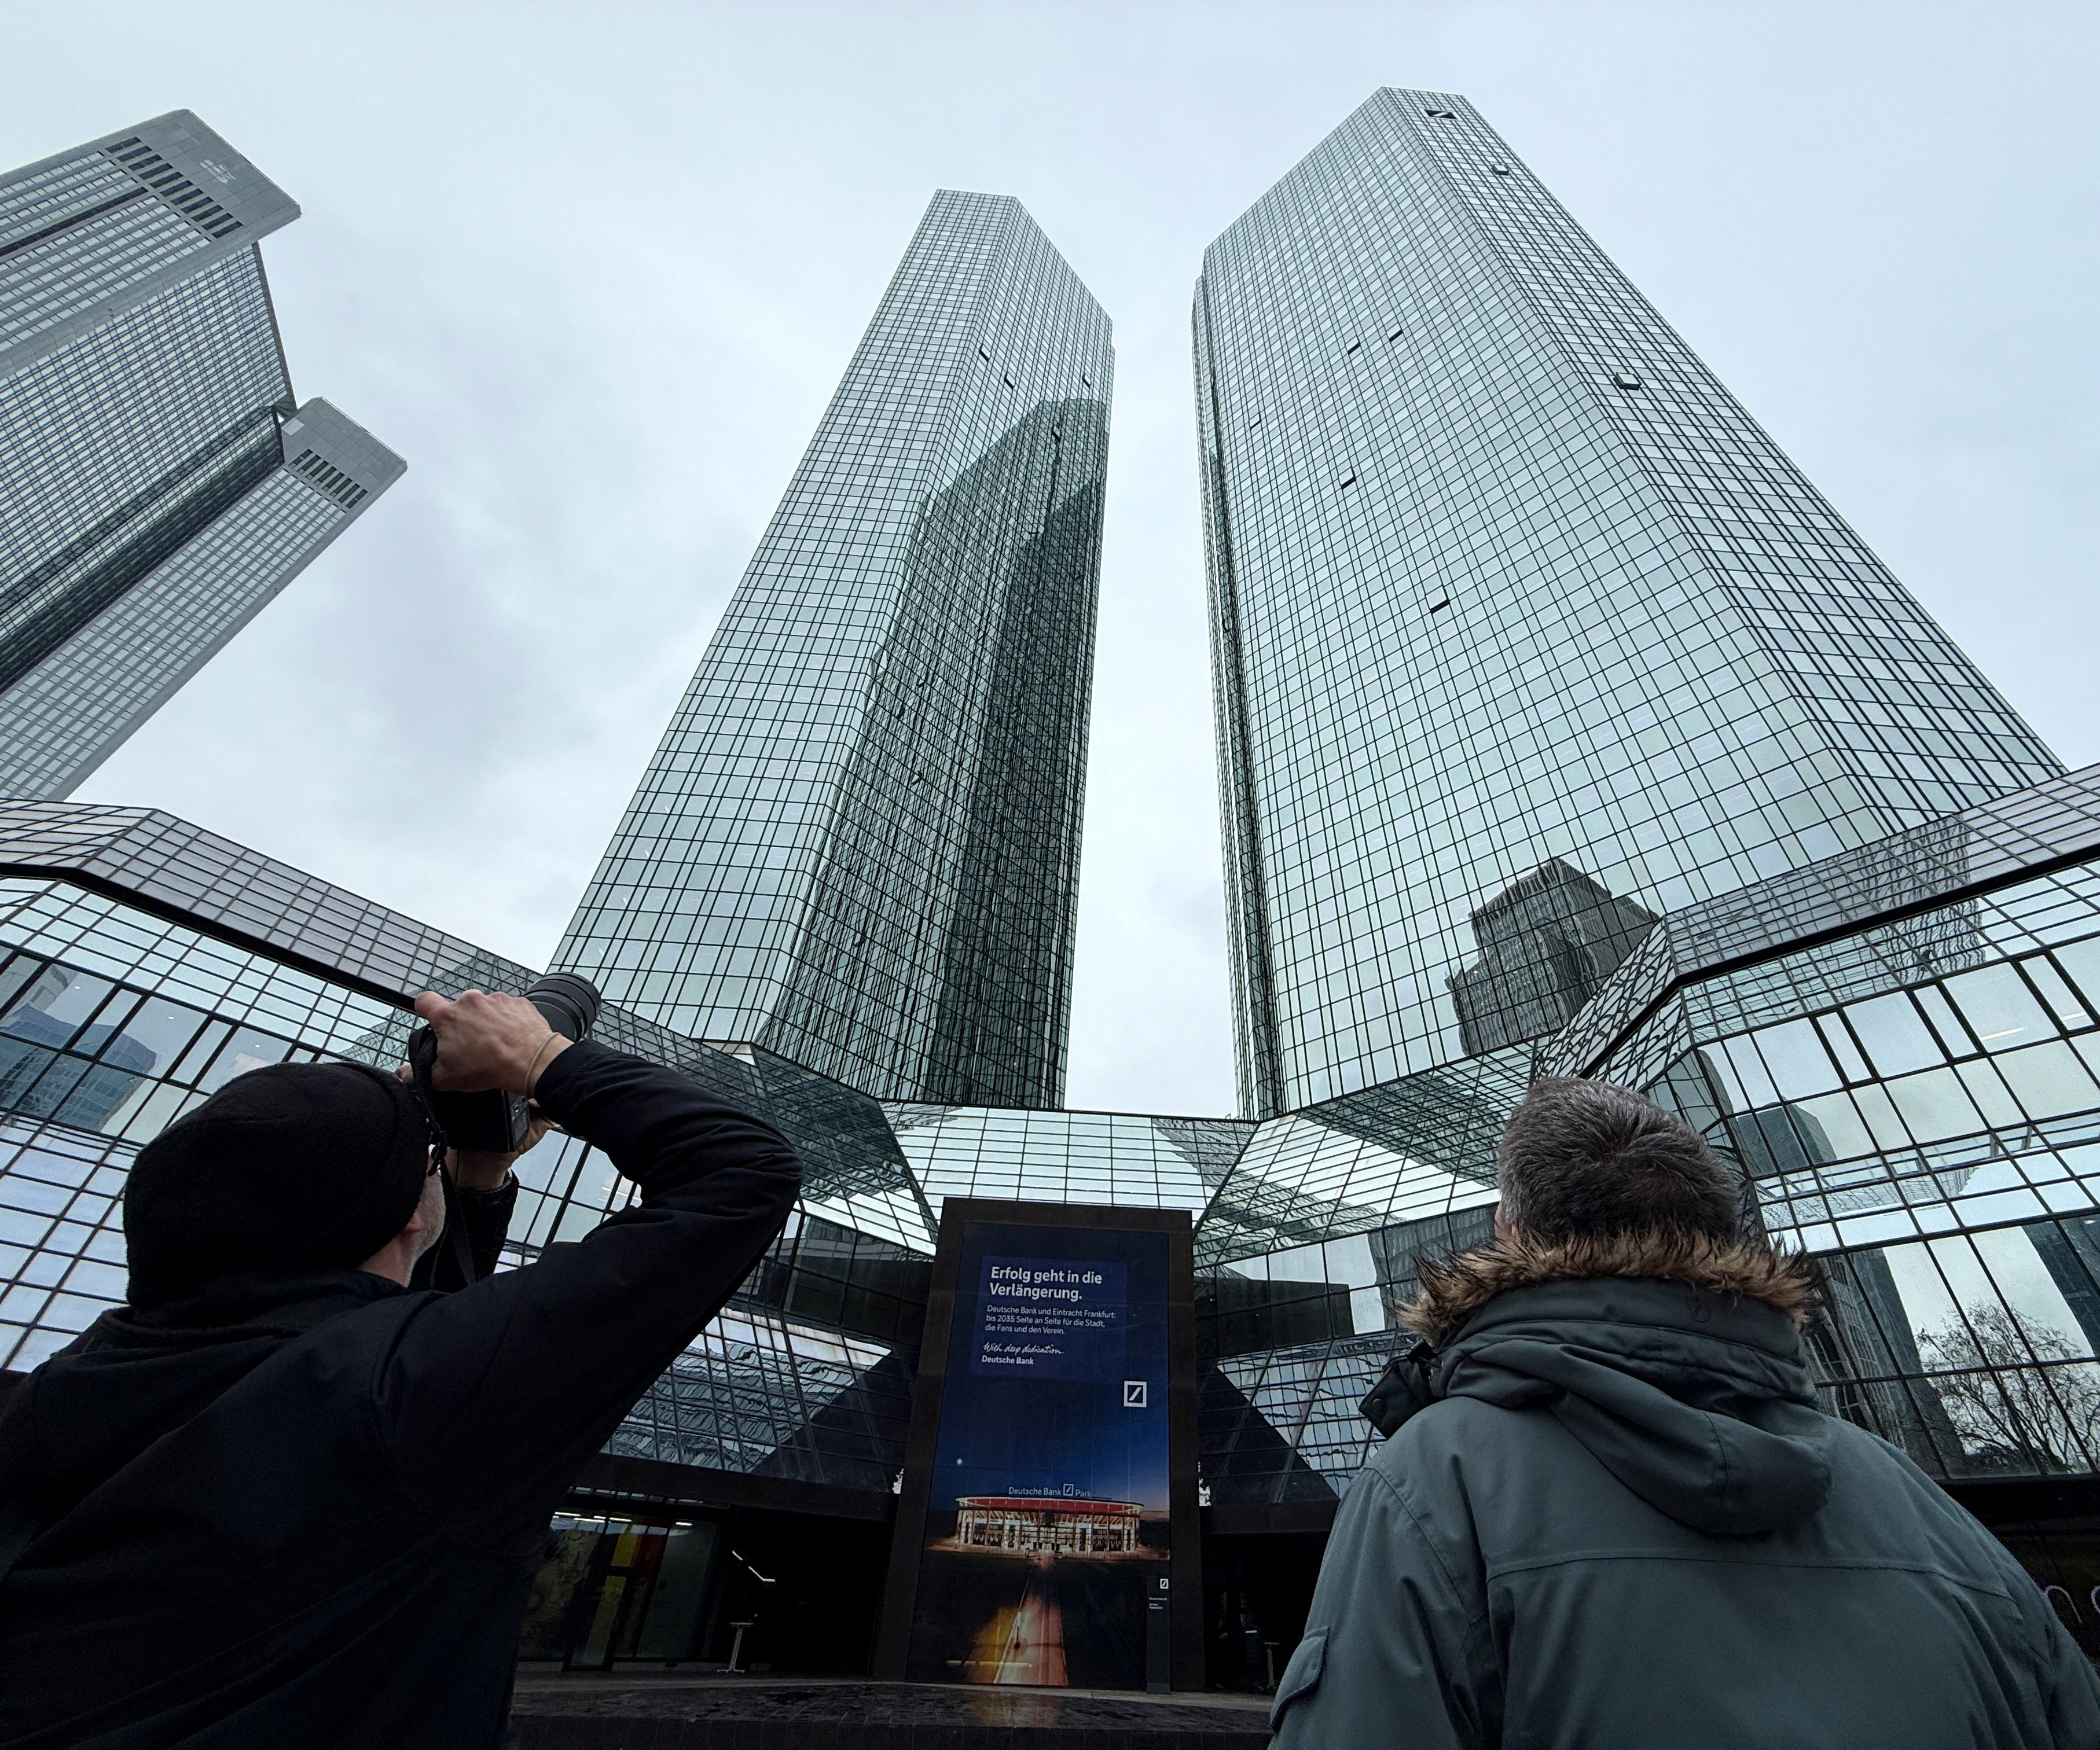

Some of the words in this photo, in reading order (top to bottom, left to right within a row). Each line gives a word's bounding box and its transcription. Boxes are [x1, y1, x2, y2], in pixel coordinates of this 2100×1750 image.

[991, 1266, 1031, 1283] Erfolg
[1034, 1269, 1064, 1284] geht
[1067, 1270, 1079, 1283] in
[1082, 1271, 1102, 1284] die
[990, 1282, 1082, 1302] Verlängerung.
[987, 1305, 1019, 1313] Deutsche
[1052, 1308, 1082, 1317] Eintracht
[1044, 1317, 1061, 1325] Seite
[1085, 1319, 1105, 1328] Stadt,
[1029, 1325, 1041, 1333] den
[983, 1342, 1003, 1352] With
[1004, 1343, 1020, 1356] deep
[982, 1355, 1015, 1363] Deutsche
[1016, 1356, 1034, 1365] Bank
[1009, 1487, 1042, 1495] Deutsche
[1043, 1487, 1062, 1496] Bank
[1075, 1489, 1092, 1497] Park
